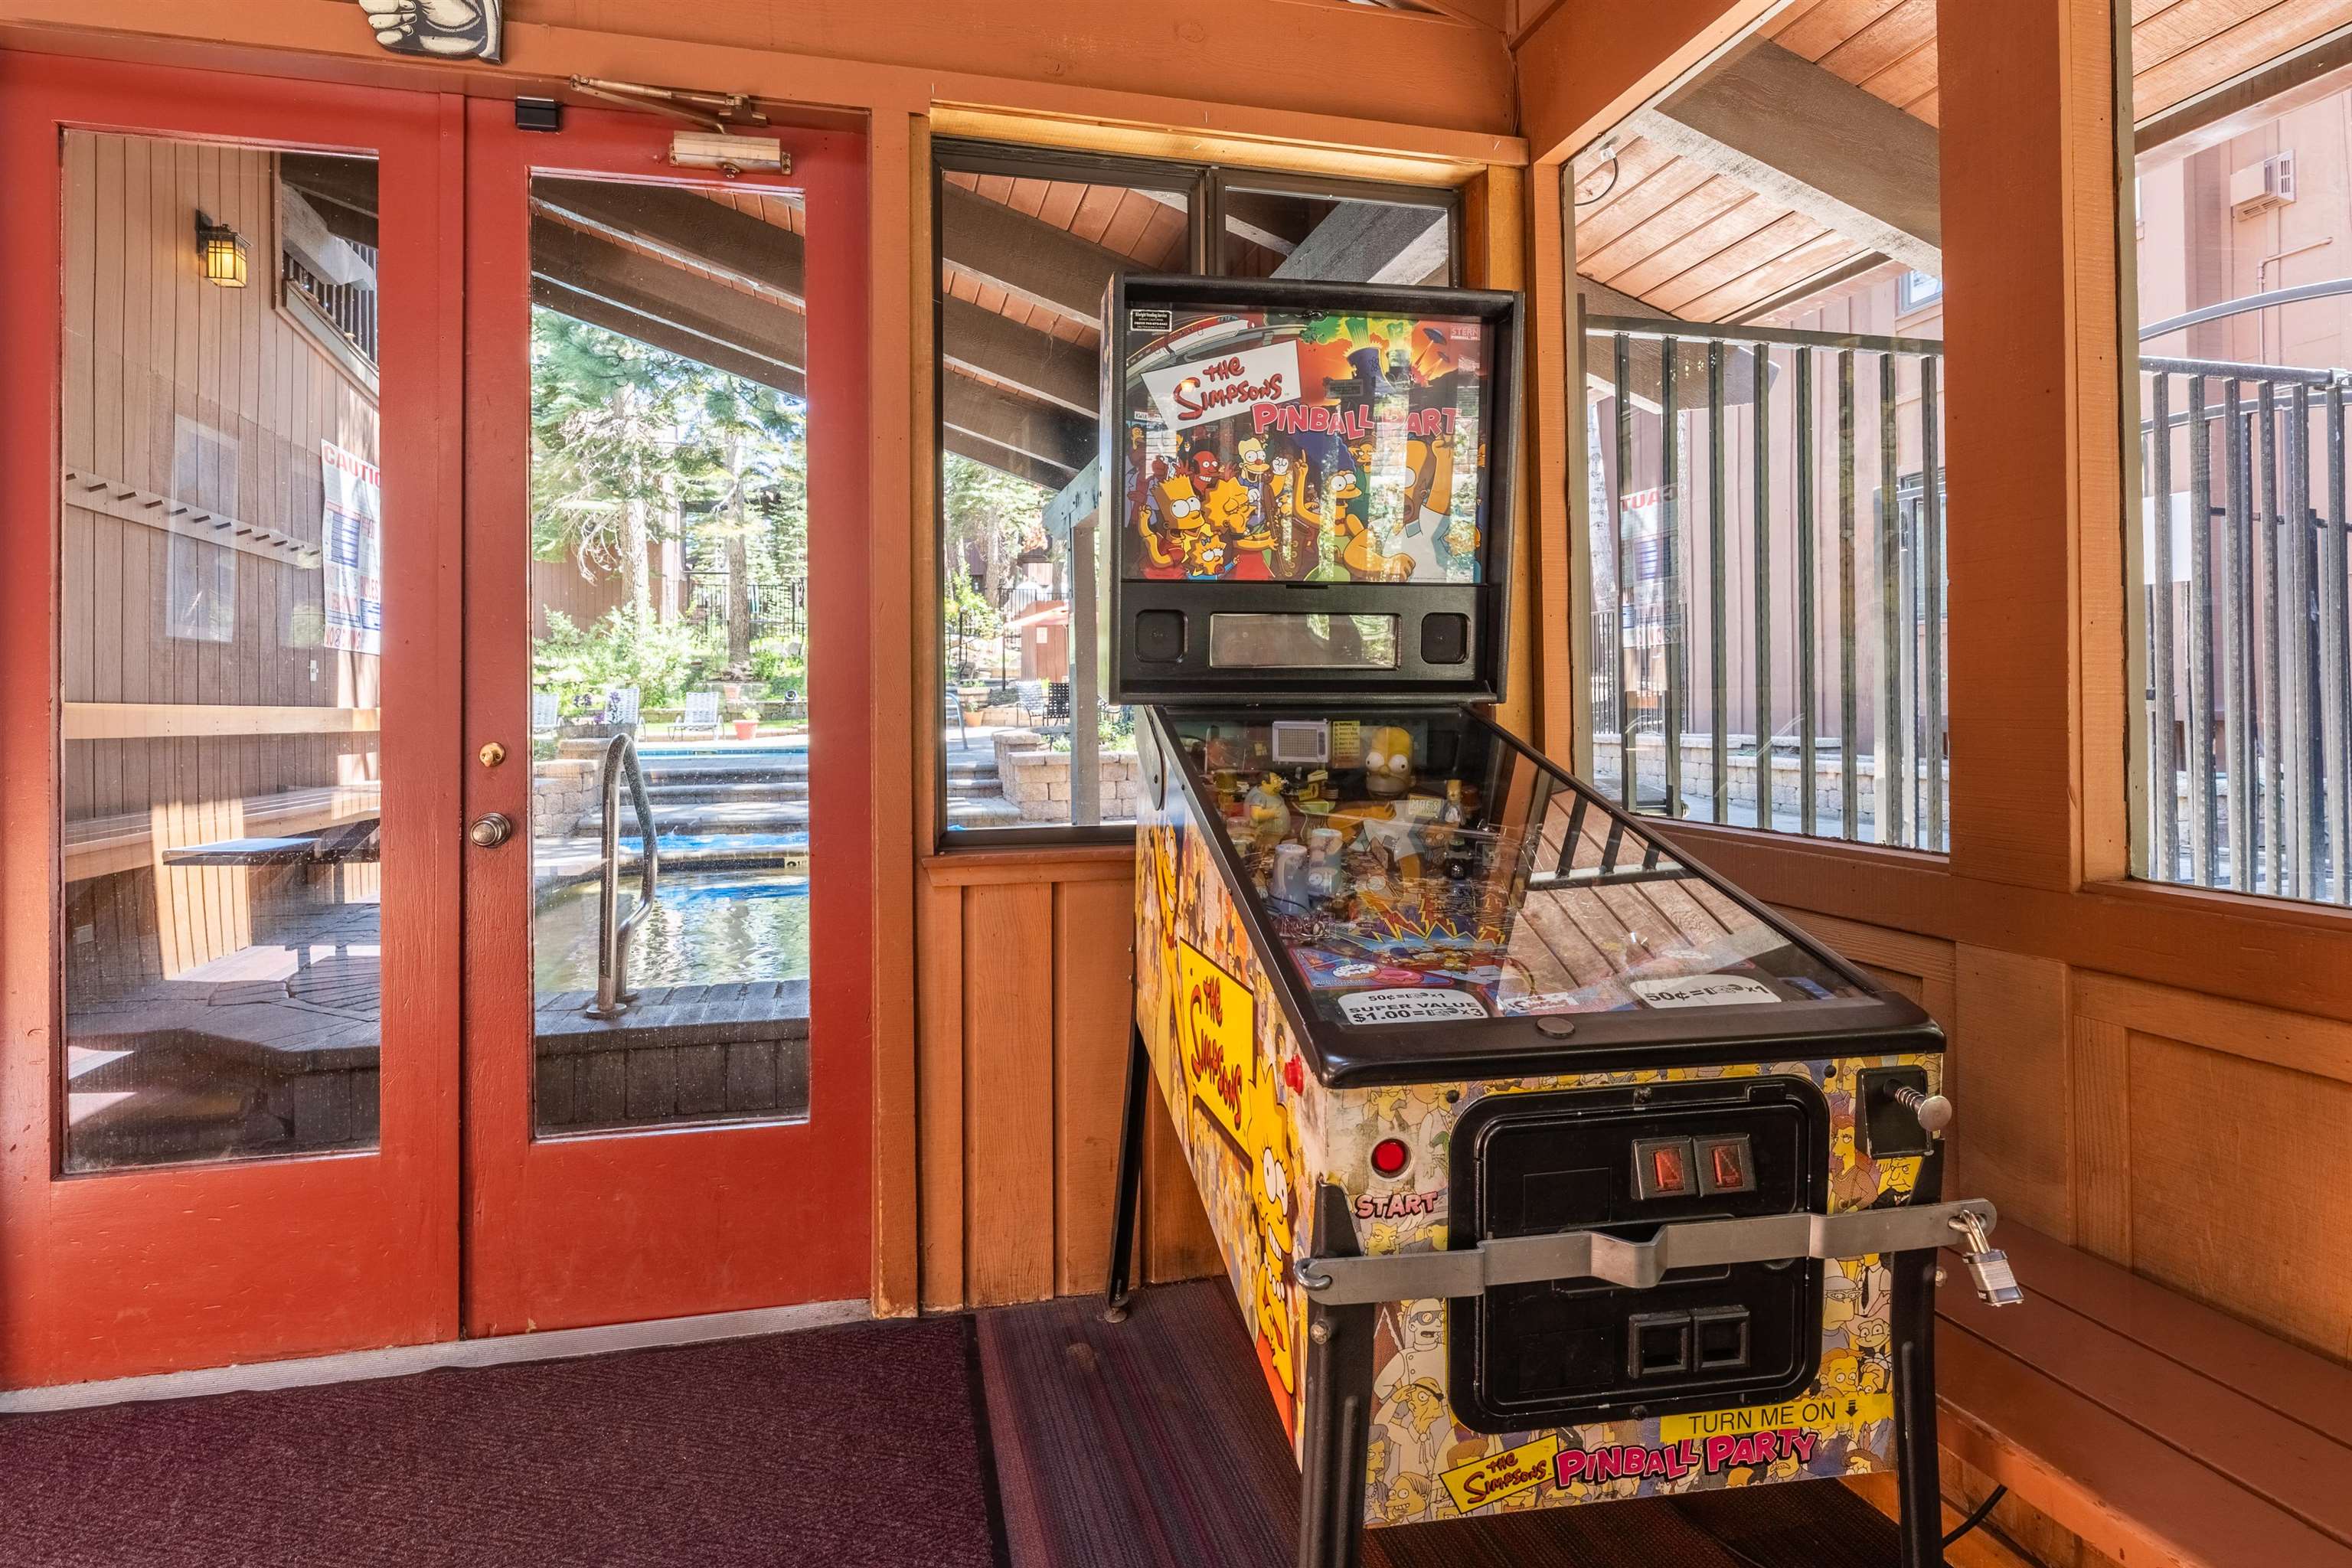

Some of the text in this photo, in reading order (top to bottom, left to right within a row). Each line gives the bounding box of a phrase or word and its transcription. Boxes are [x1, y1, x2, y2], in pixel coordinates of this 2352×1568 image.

[1252, 402, 1374, 439] PINBALL
[1349, 1001, 1478, 1014] SUPER VALUE
[1354, 1191, 1438, 1219] START
[1688, 1402, 1836, 1435] TURN ME ON
[1555, 1427, 1820, 1490] PINBALL PARTY
